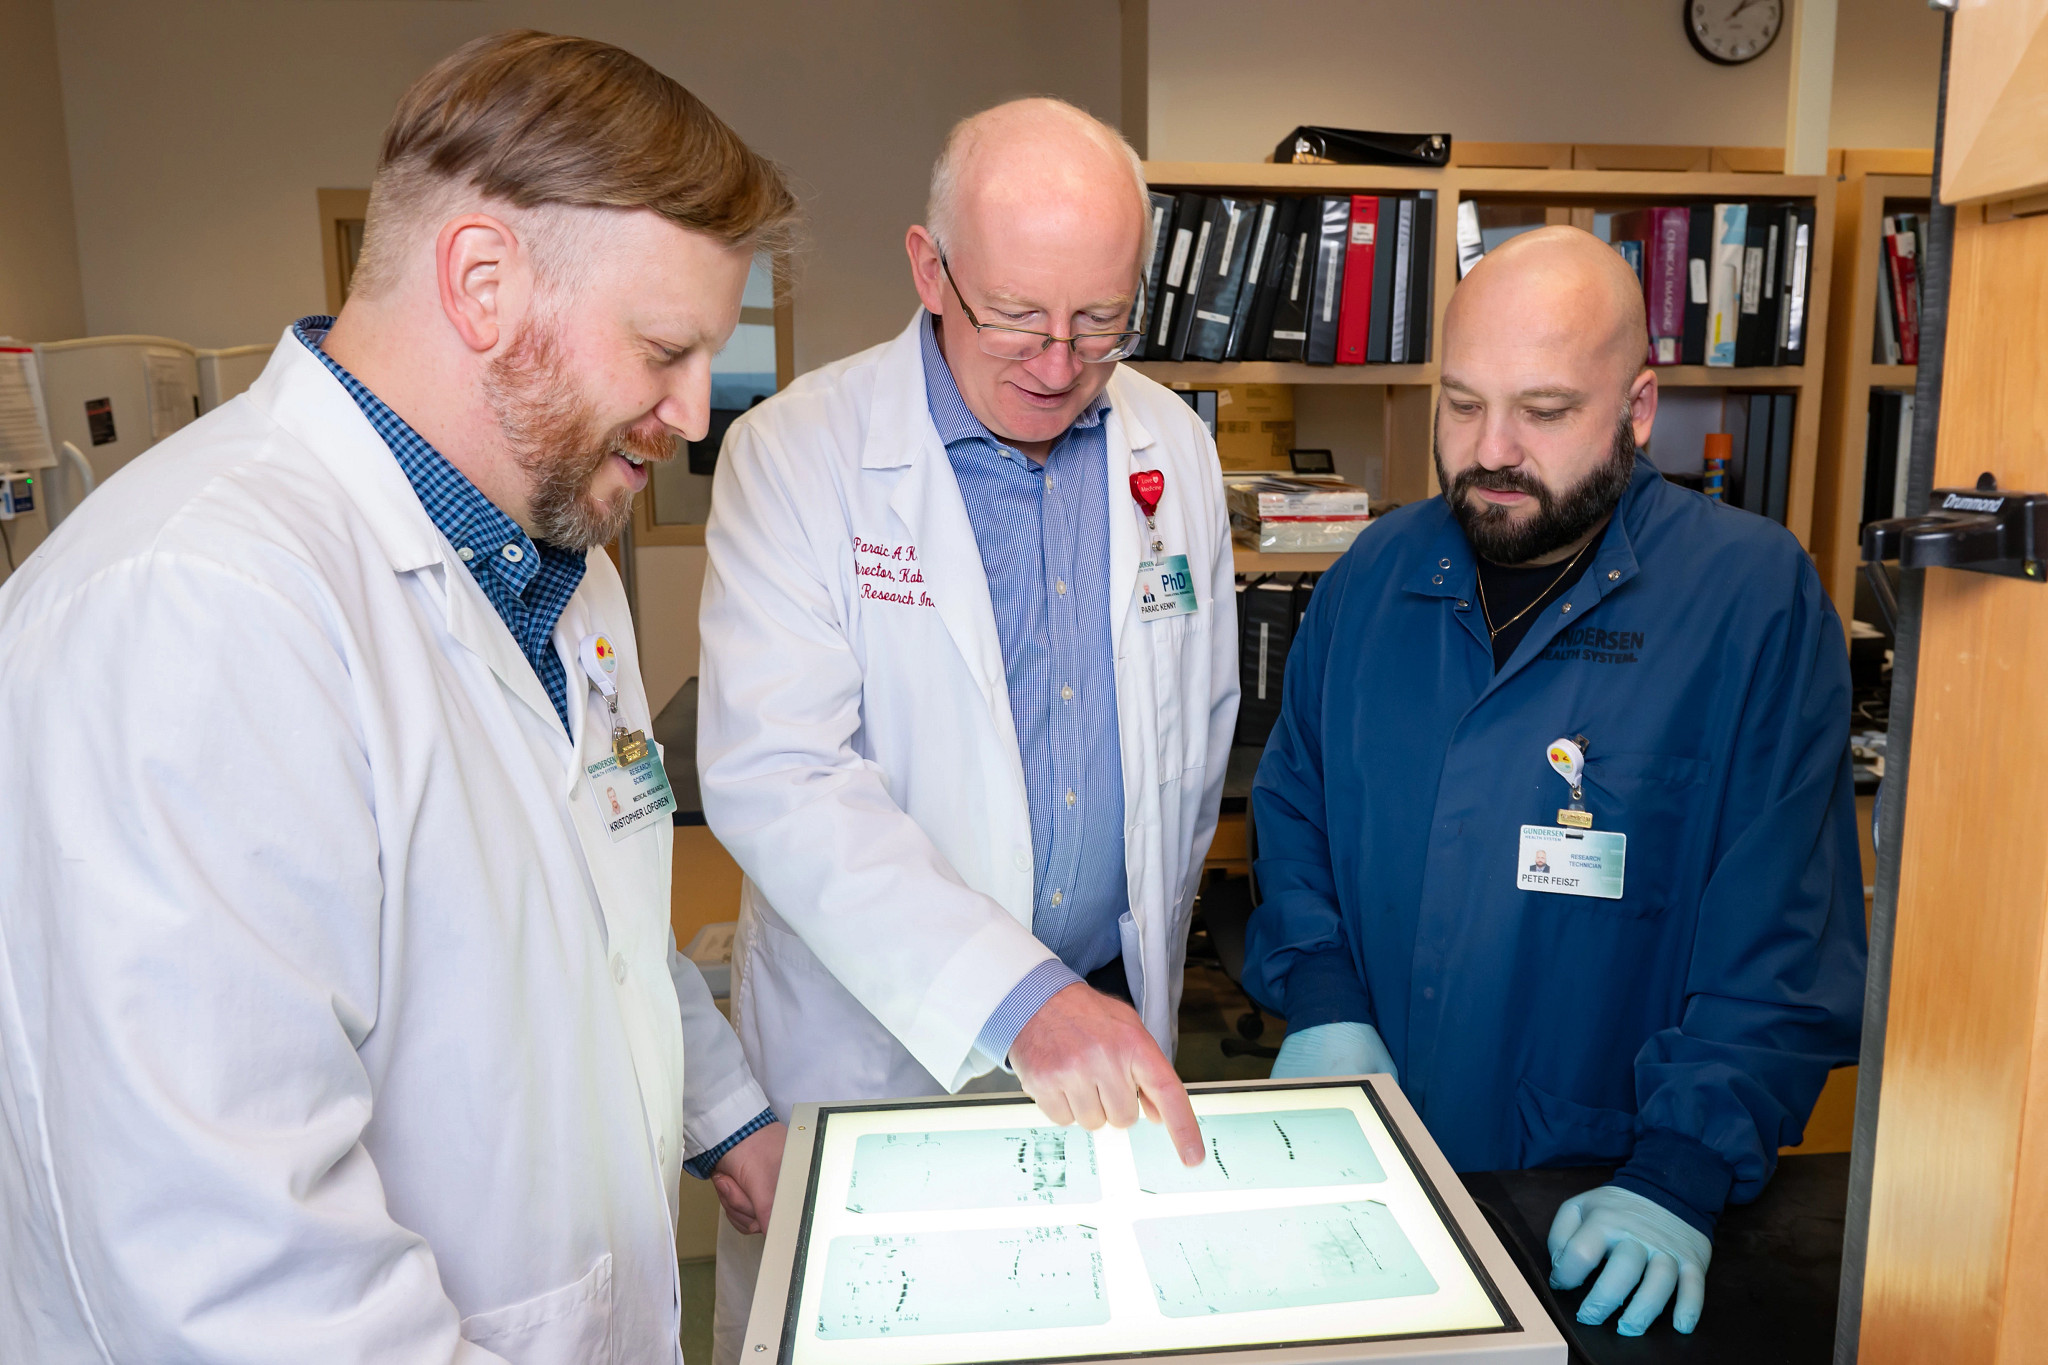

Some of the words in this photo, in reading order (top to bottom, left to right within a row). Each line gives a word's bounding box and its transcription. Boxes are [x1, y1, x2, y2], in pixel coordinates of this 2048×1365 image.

[1665, 229, 1676, 277] CLINICAL
[1663, 281, 1673, 331] IMAGING
[1942, 493, 2005, 513] Drummond
[853, 537, 890, 557] Paraic
[892, 546, 902, 561] A
[905, 546, 918, 561] K
[855, 560, 895, 582] irector,
[899, 568, 924, 583] Kab
[1161, 572, 1186, 592] PhD
[861, 583, 915, 605] Research
[1141, 603, 1160, 614] PARAIC
[1160, 601, 1177, 611] KENNY
[1552, 627, 1645, 650] NDERSEN
[629, 762, 652, 776] RESEARCH
[633, 771, 654, 785] SCIENTIST
[632, 792, 648, 803] MEDICAL
[647, 784, 665, 796] RESEARCH
[610, 809, 645, 832] KRISTOPHER
[644, 796, 670, 815] LOFGREN
[1523, 827, 1564, 837] GUNDERSEN
[1569, 861, 1602, 869] TECHNICIAN
[1571, 853, 1601, 862] RESEARCH
[1521, 874, 1549, 885] PETER
[1551, 876, 1580, 887] FEISZT
